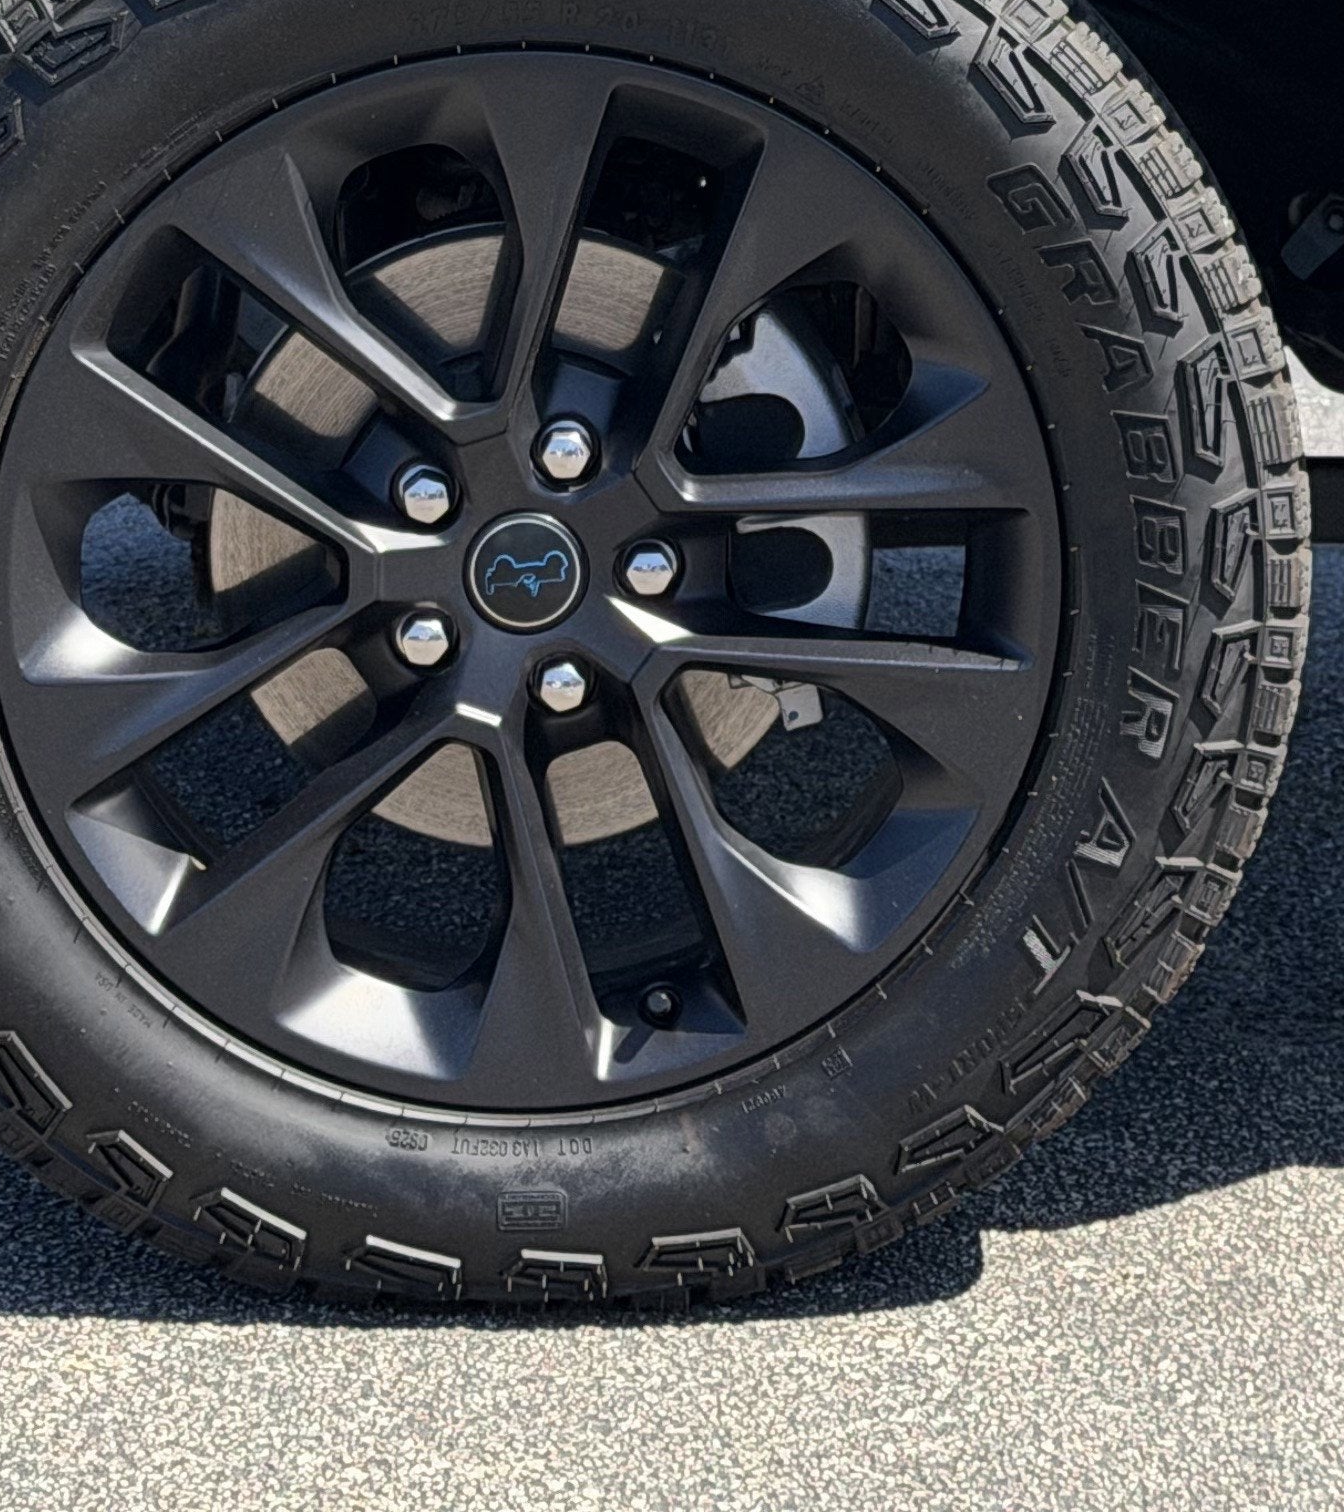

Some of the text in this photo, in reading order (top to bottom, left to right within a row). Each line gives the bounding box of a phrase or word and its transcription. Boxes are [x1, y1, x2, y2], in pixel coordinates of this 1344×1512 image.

[987, 164, 1196, 764] GRABBER
[1022, 775, 1135, 998] A/T
[557, 1136, 593, 1156] DOT
